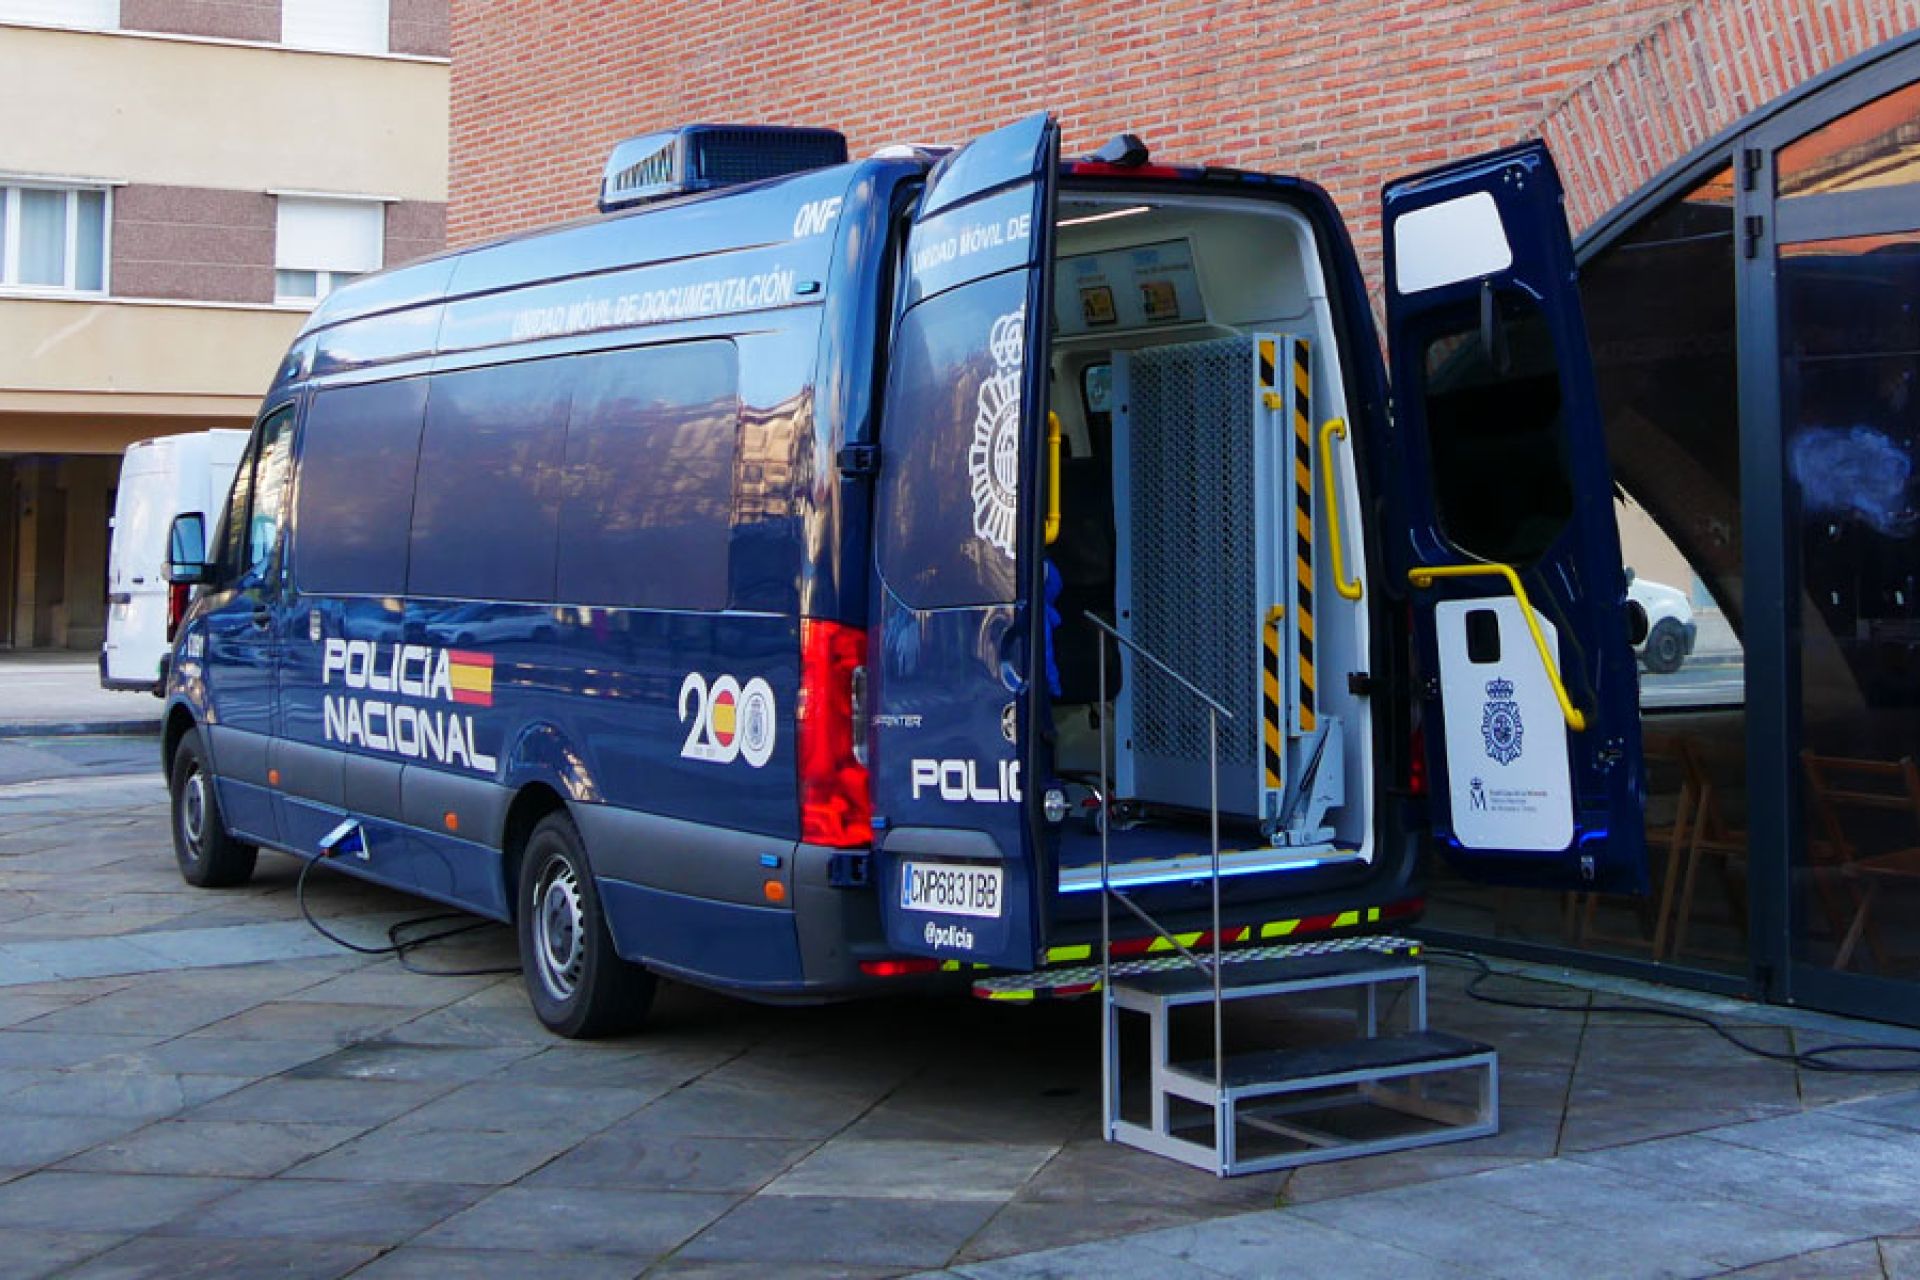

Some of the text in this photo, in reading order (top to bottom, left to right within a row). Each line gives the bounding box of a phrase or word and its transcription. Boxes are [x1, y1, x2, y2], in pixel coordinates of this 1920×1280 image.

[1007, 214, 1030, 242] DE
[639, 265, 795, 322] DOCUMENTACIÓN
[323, 694, 496, 773] NACIONAL
[678, 671, 776, 769] 200
